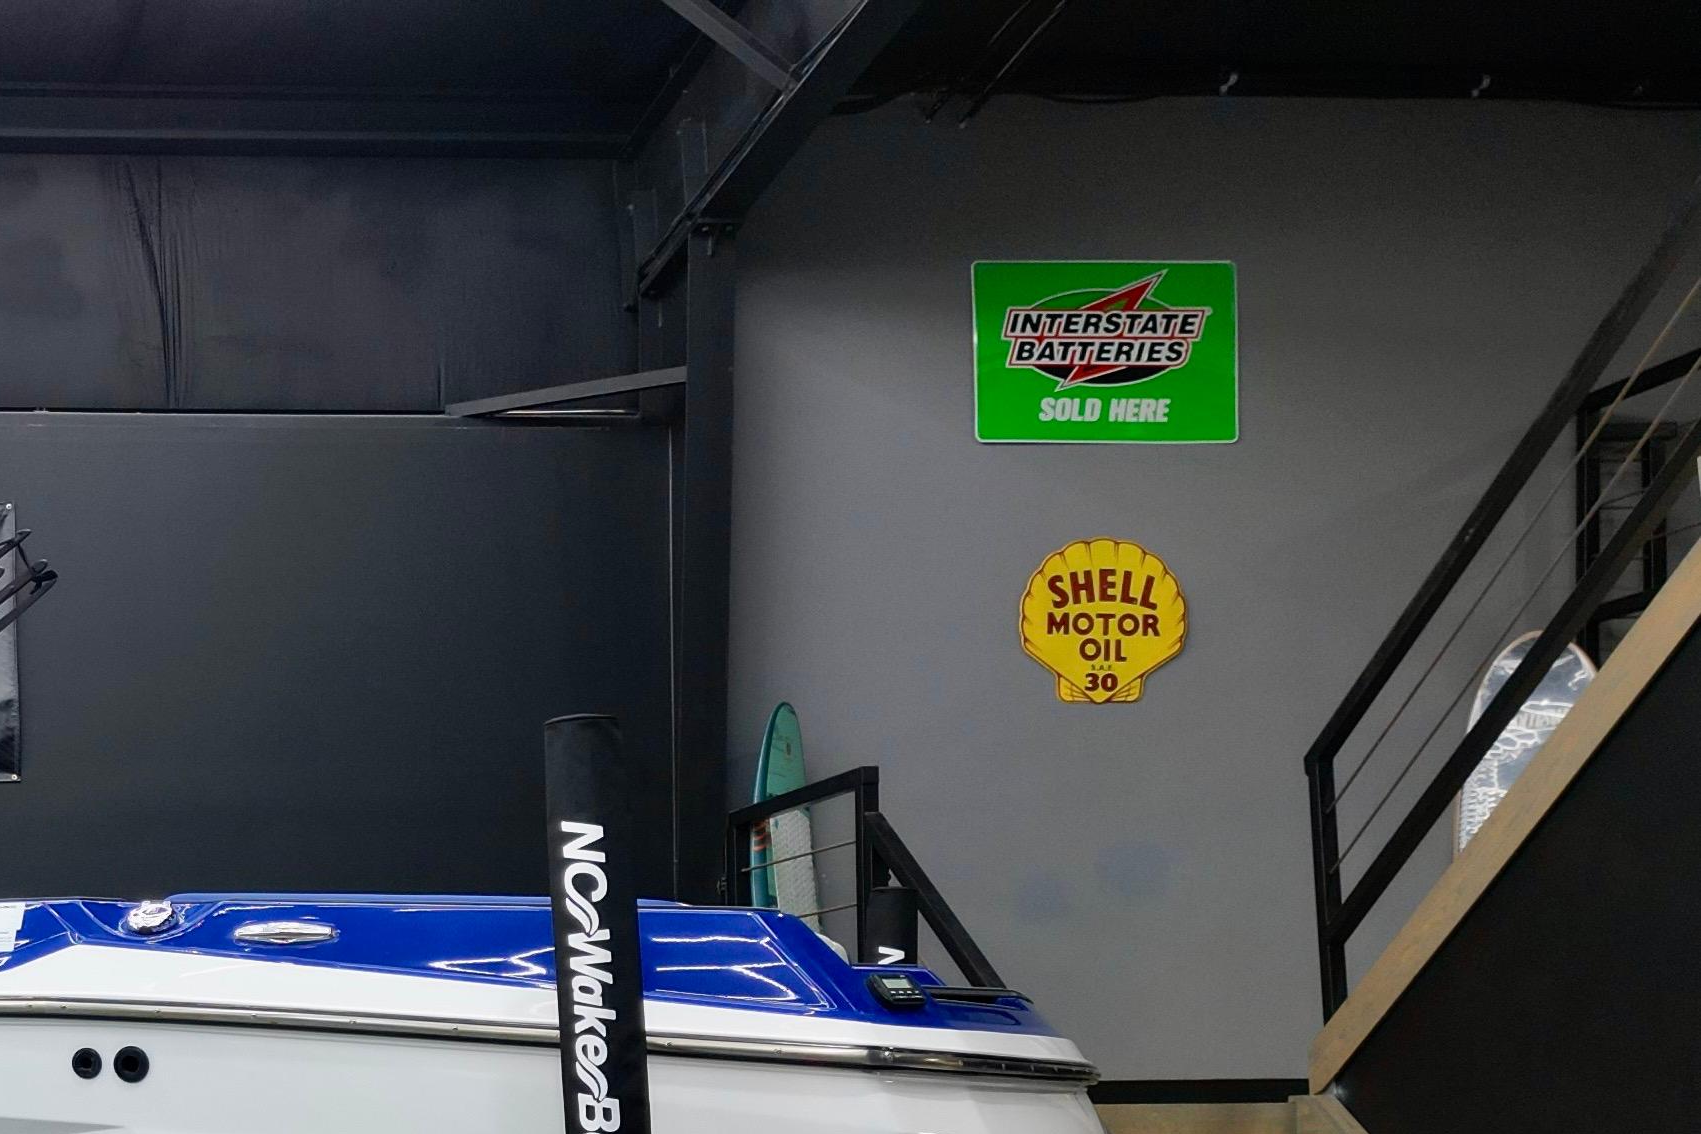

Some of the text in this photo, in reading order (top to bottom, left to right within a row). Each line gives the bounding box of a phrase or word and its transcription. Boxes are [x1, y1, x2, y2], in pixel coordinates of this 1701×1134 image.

[1008, 311, 1200, 336] INTERSTATE
[1015, 340, 1186, 363] BATTERIES
[1038, 397, 1172, 423] SOLD HERE
[1047, 568, 1158, 611] SHELL
[1046, 612, 1161, 637] MOTOR
[1078, 637, 1127, 662] OIL
[1084, 672, 1119, 692] 30
[567, 928, 617, 1066] Wake
